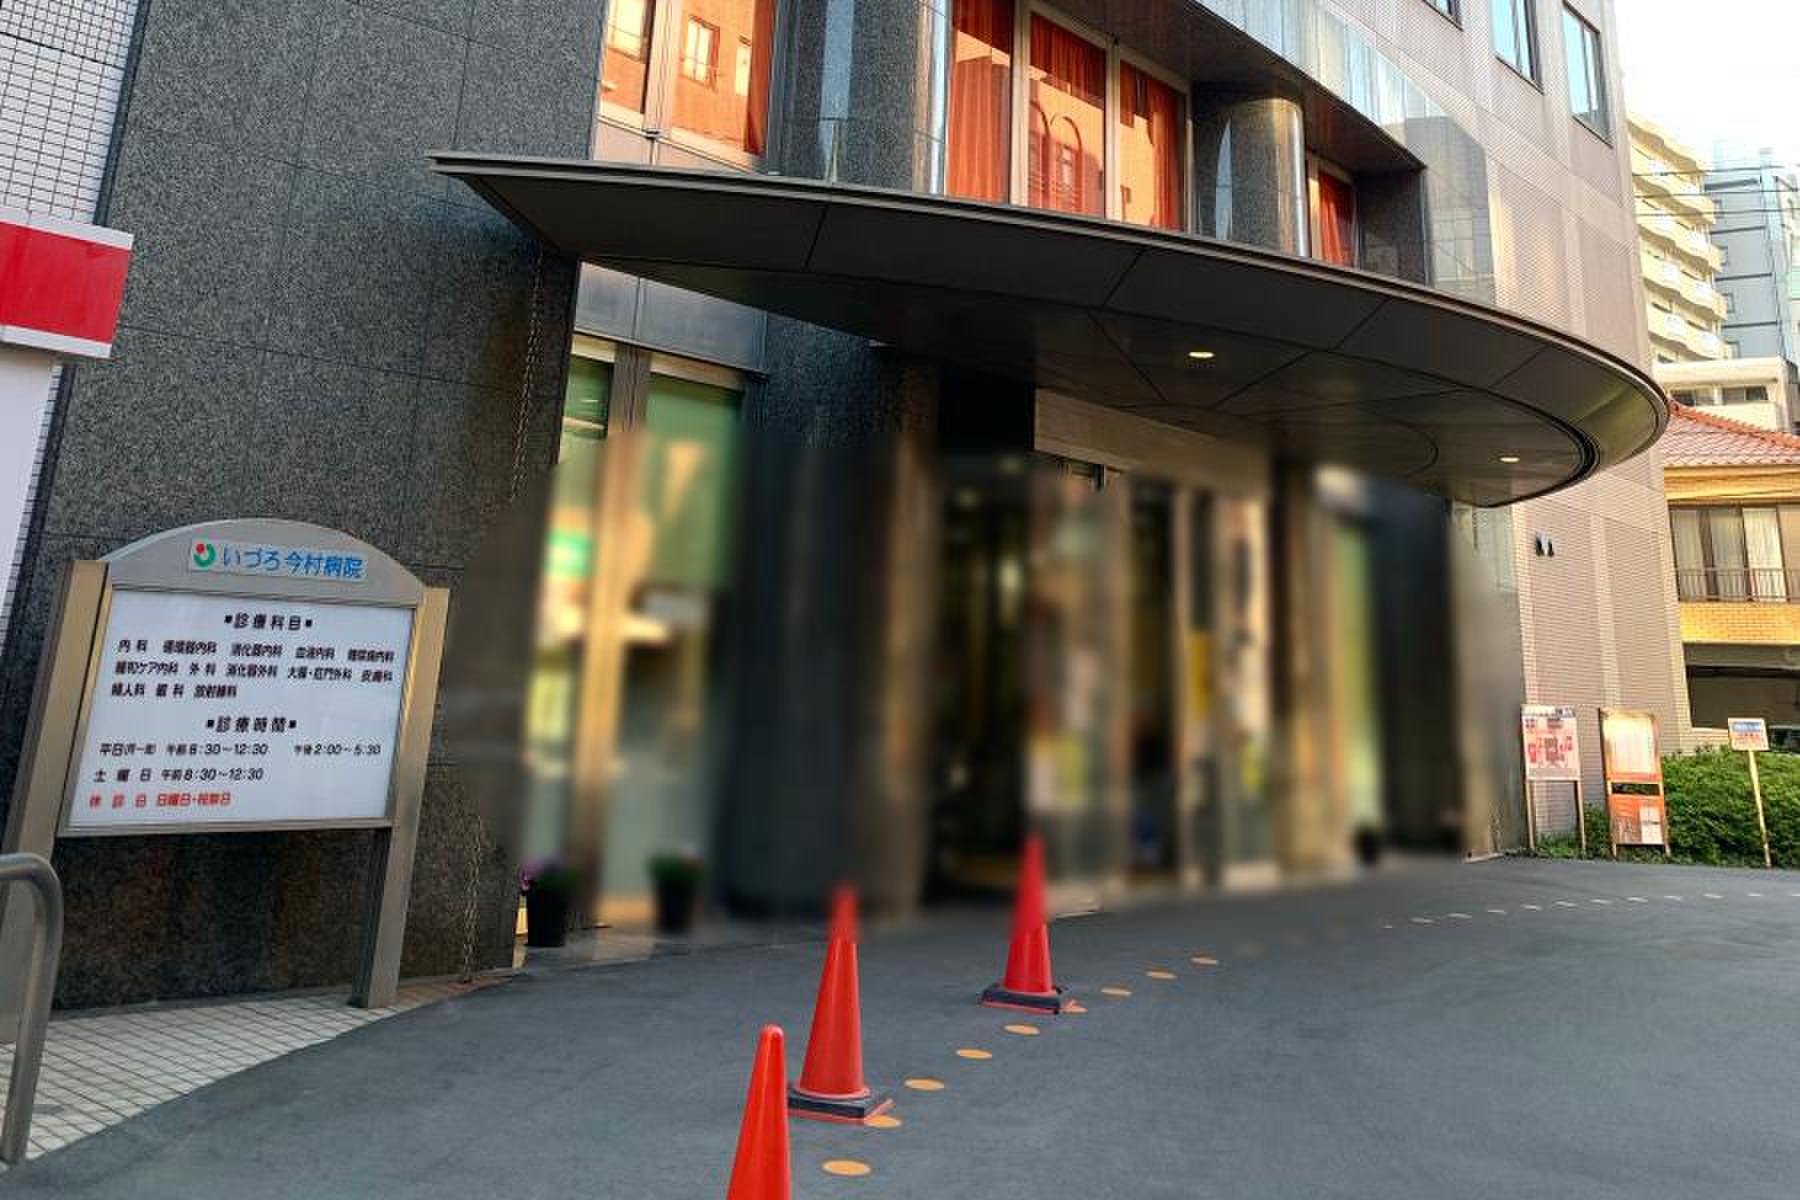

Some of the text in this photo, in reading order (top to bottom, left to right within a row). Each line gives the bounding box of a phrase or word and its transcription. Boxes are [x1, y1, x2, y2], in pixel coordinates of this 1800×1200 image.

[223, 547, 363, 579] いづろ今村病院
[234, 612, 301, 631] 診療科目
[118, 639, 148, 653] 内科
[189, 661, 216, 676] 外科
[216, 716, 287, 733] 診療時間
[93, 767, 152, 783] 土曜日
